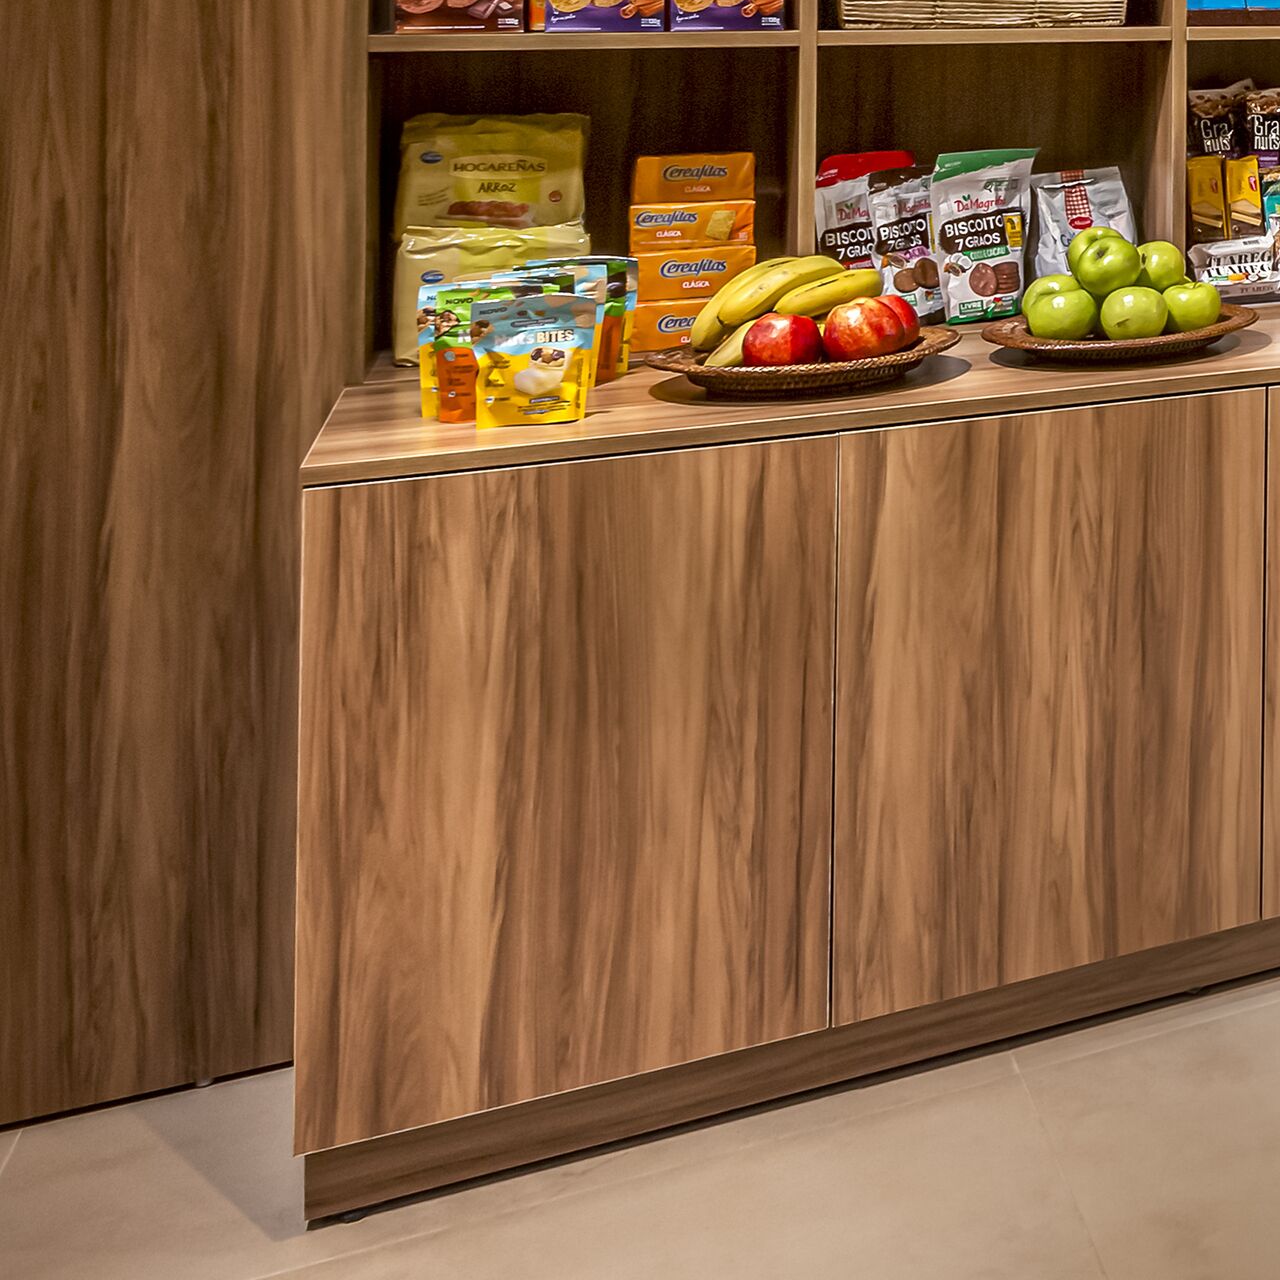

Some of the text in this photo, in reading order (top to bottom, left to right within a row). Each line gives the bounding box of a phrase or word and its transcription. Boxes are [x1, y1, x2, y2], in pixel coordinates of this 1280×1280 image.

[1201, 119, 1229, 139] Gra
[1253, 115, 1280, 136] Gra
[1203, 138, 1231, 153] nuts
[453, 159, 546, 172] HOGAREÑAS
[662, 164, 728, 183] Cerealitas
[477, 182, 517, 194] ARROZ
[635, 210, 698, 228] Cerealitas
[825, 228, 873, 246] BISCOIT
[888, 240, 894, 251] 7
[955, 239, 963, 251] 7
[836, 248, 845, 260] 7
[660, 259, 727, 279] Cerealitas
[682, 280, 710, 289] CLÁSICA
[445, 297, 474, 306] NOVO
[960, 301, 983, 310] LIVRE
[657, 314, 696, 334] Cerea
[536, 328, 575, 343] BITES
